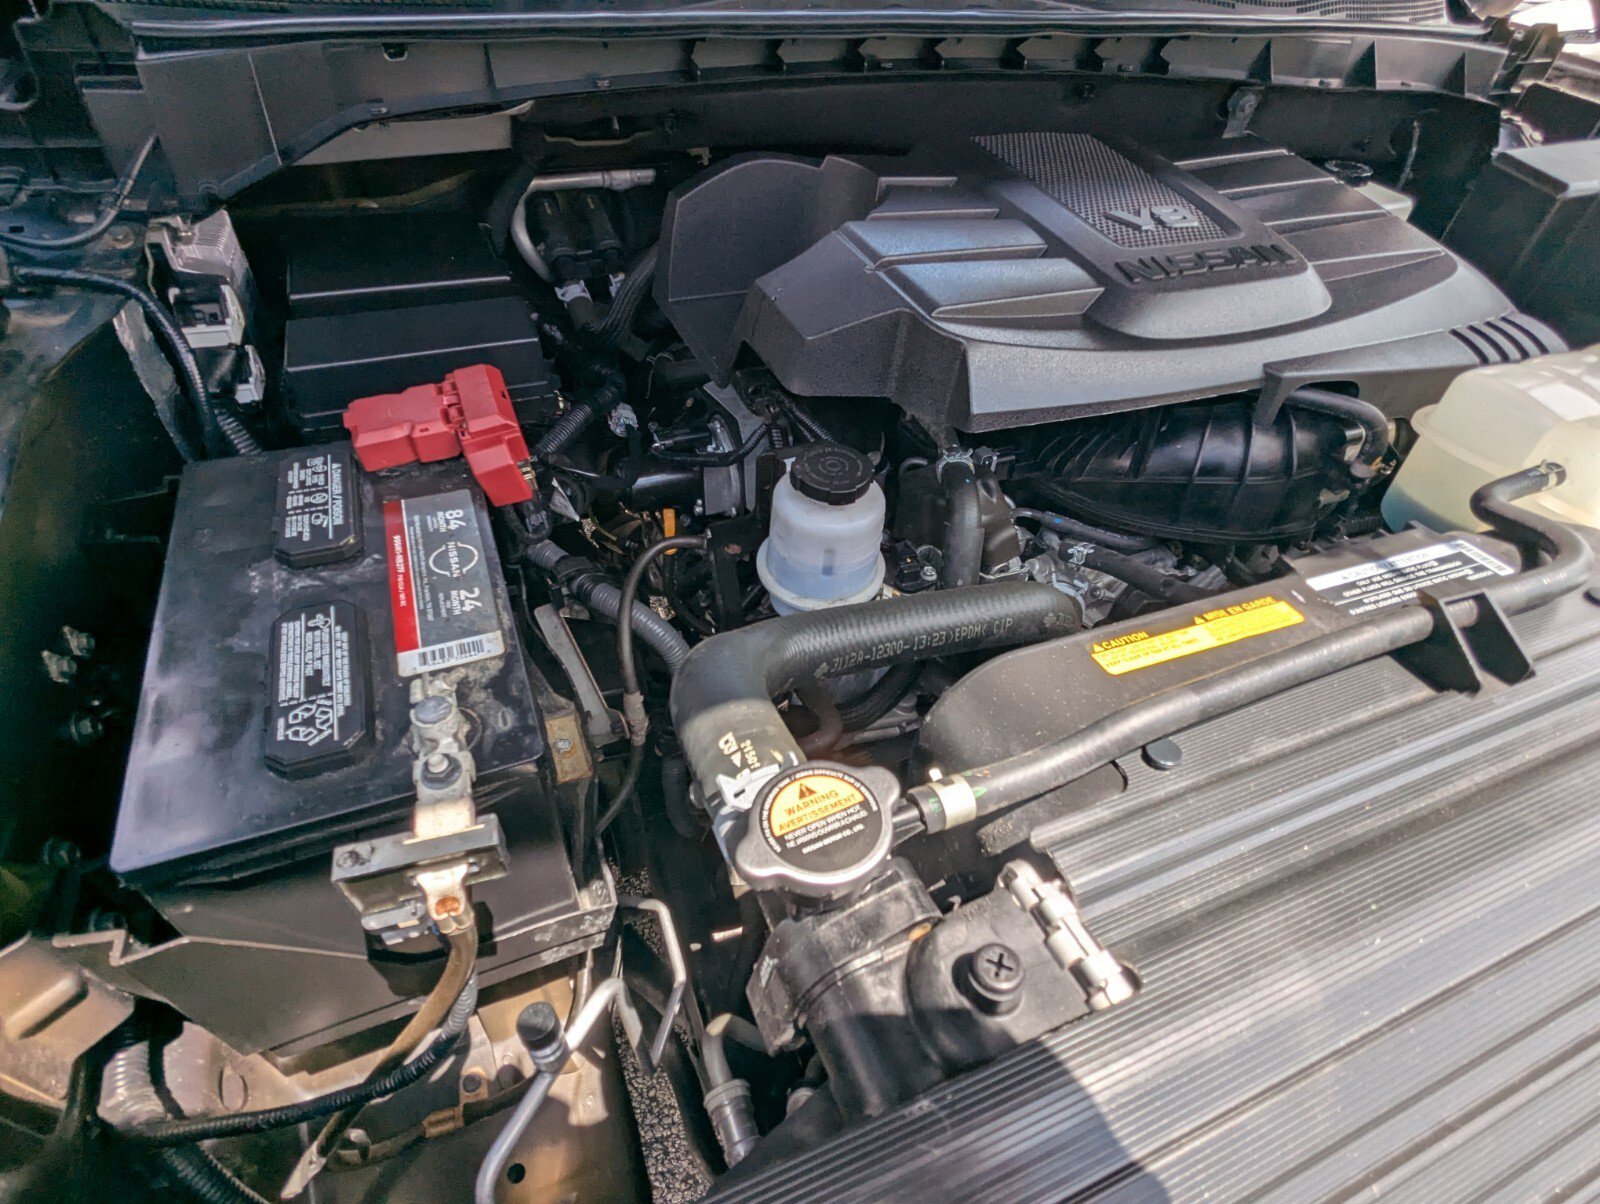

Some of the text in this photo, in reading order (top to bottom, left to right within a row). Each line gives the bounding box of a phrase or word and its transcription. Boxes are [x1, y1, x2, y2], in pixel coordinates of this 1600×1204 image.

[1103, 204, 1198, 231] V8
[1115, 244, 1297, 283] NISSAN
[333, 499, 344, 525] POISON
[437, 511, 446, 532] MONTH
[445, 509, 466, 530] 84
[447, 541, 461, 577] NISSAN
[450, 590, 461, 615] MONTH
[460, 587, 482, 612] 24
[1203, 596, 1276, 621] MISE EN GARDE
[1102, 631, 1149, 650] CAUTION
[779, 794, 857, 831] AVERTISSEMENT
[785, 789, 839, 816] WARNING
[784, 828, 807, 841] NEVER
[807, 820, 827, 832] OPEN
[826, 811, 847, 823] WHEN
